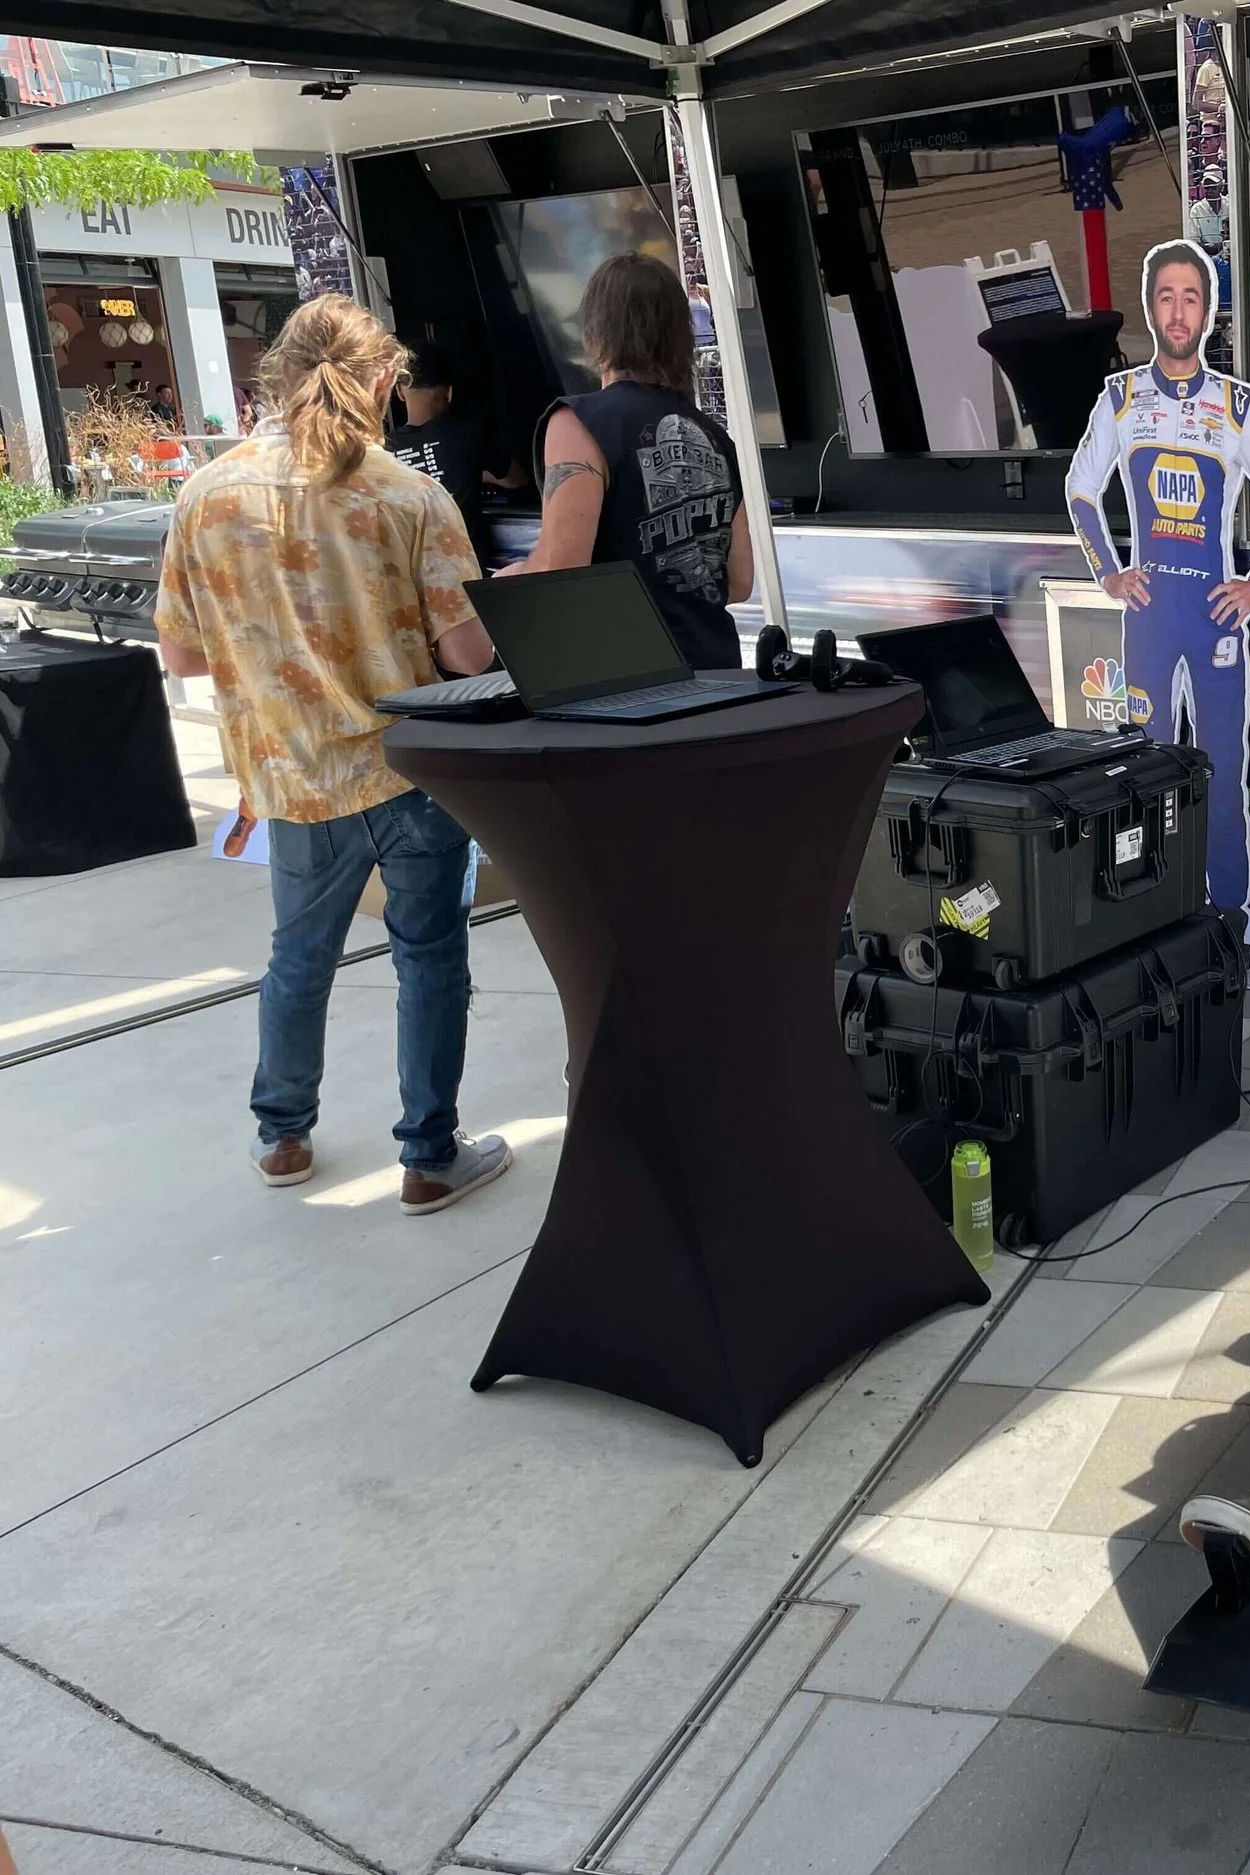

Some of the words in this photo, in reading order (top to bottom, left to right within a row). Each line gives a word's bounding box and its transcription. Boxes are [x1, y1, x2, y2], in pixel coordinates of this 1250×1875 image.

[927, 130, 968, 147] COMBO
[81, 199, 132, 235] EAT
[1158, 469, 1197, 503] NAPA
[1151, 518, 1176, 534] AUTO
[1177, 522, 1207, 539] PARTS
[1157, 564, 1211, 580] ELLIOTT
[1211, 635, 1239, 669] 9
